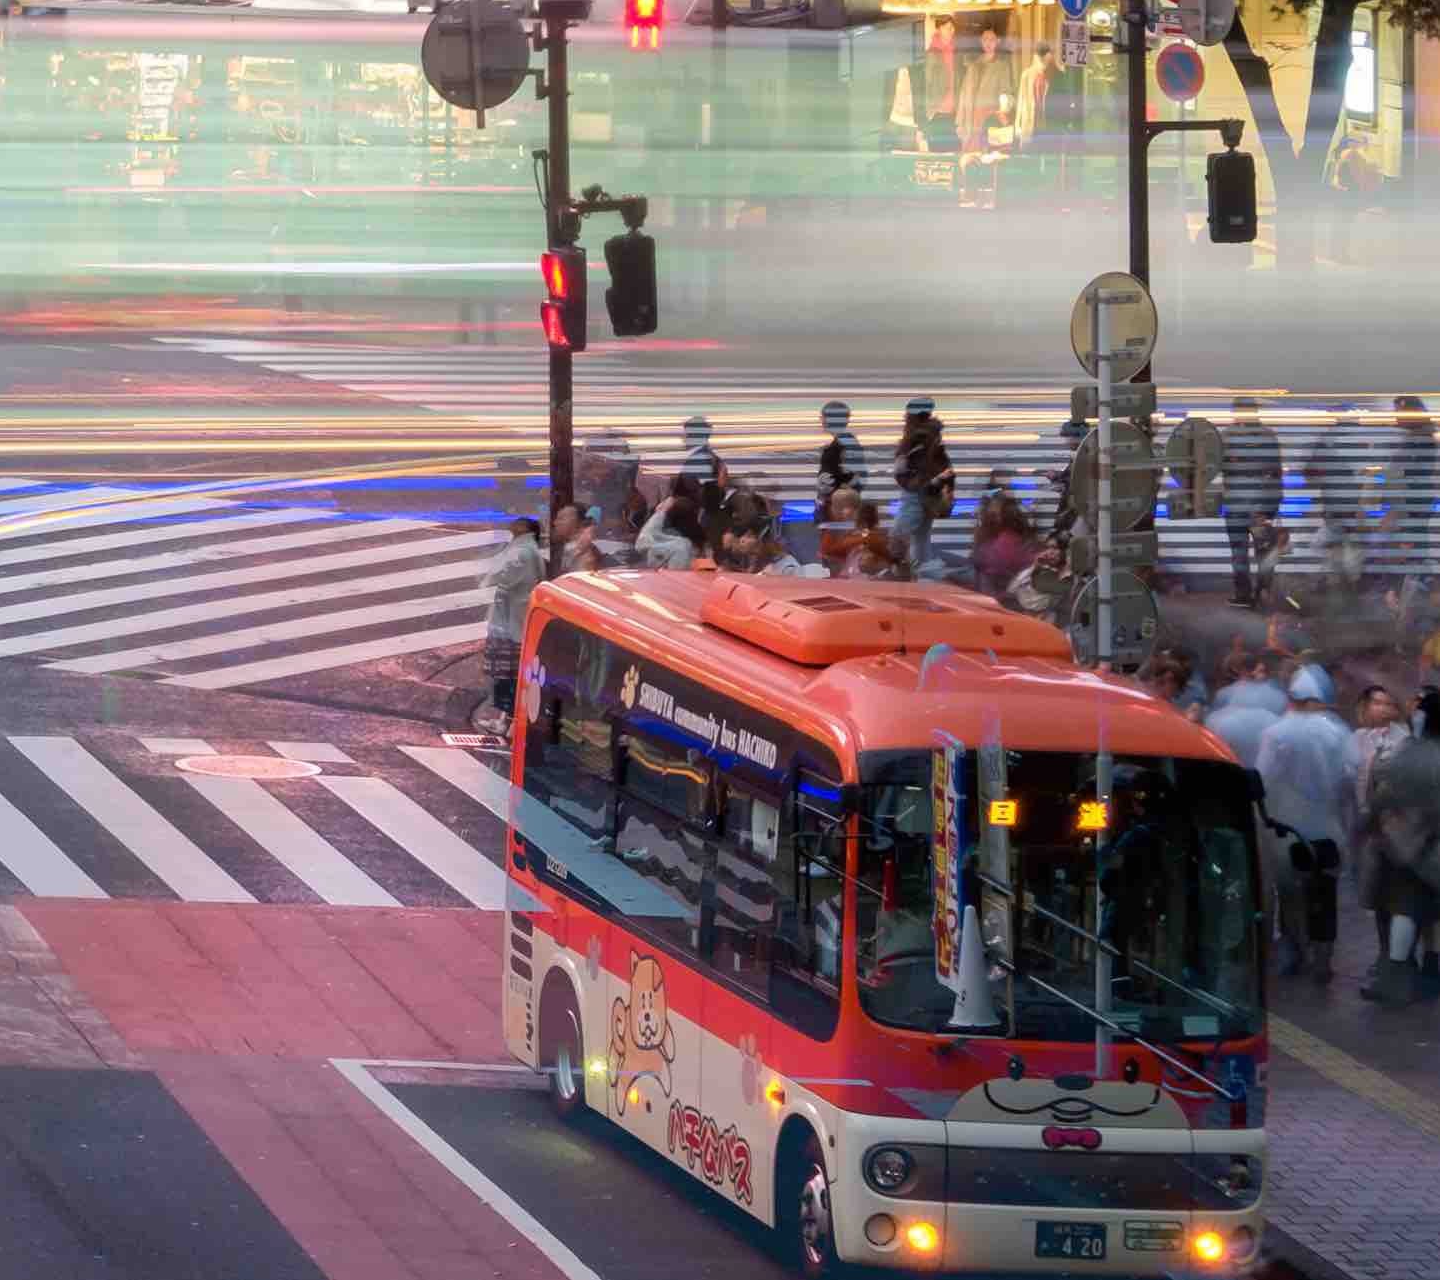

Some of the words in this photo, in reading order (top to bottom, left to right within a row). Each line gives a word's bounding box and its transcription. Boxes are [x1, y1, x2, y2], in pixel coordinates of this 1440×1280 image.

[639, 682, 675, 721] SHIBUYA
[720, 719, 738, 751] bus
[737, 728, 778, 770] HACHIKO
[667, 1099, 753, 1206] ハチ公バス
